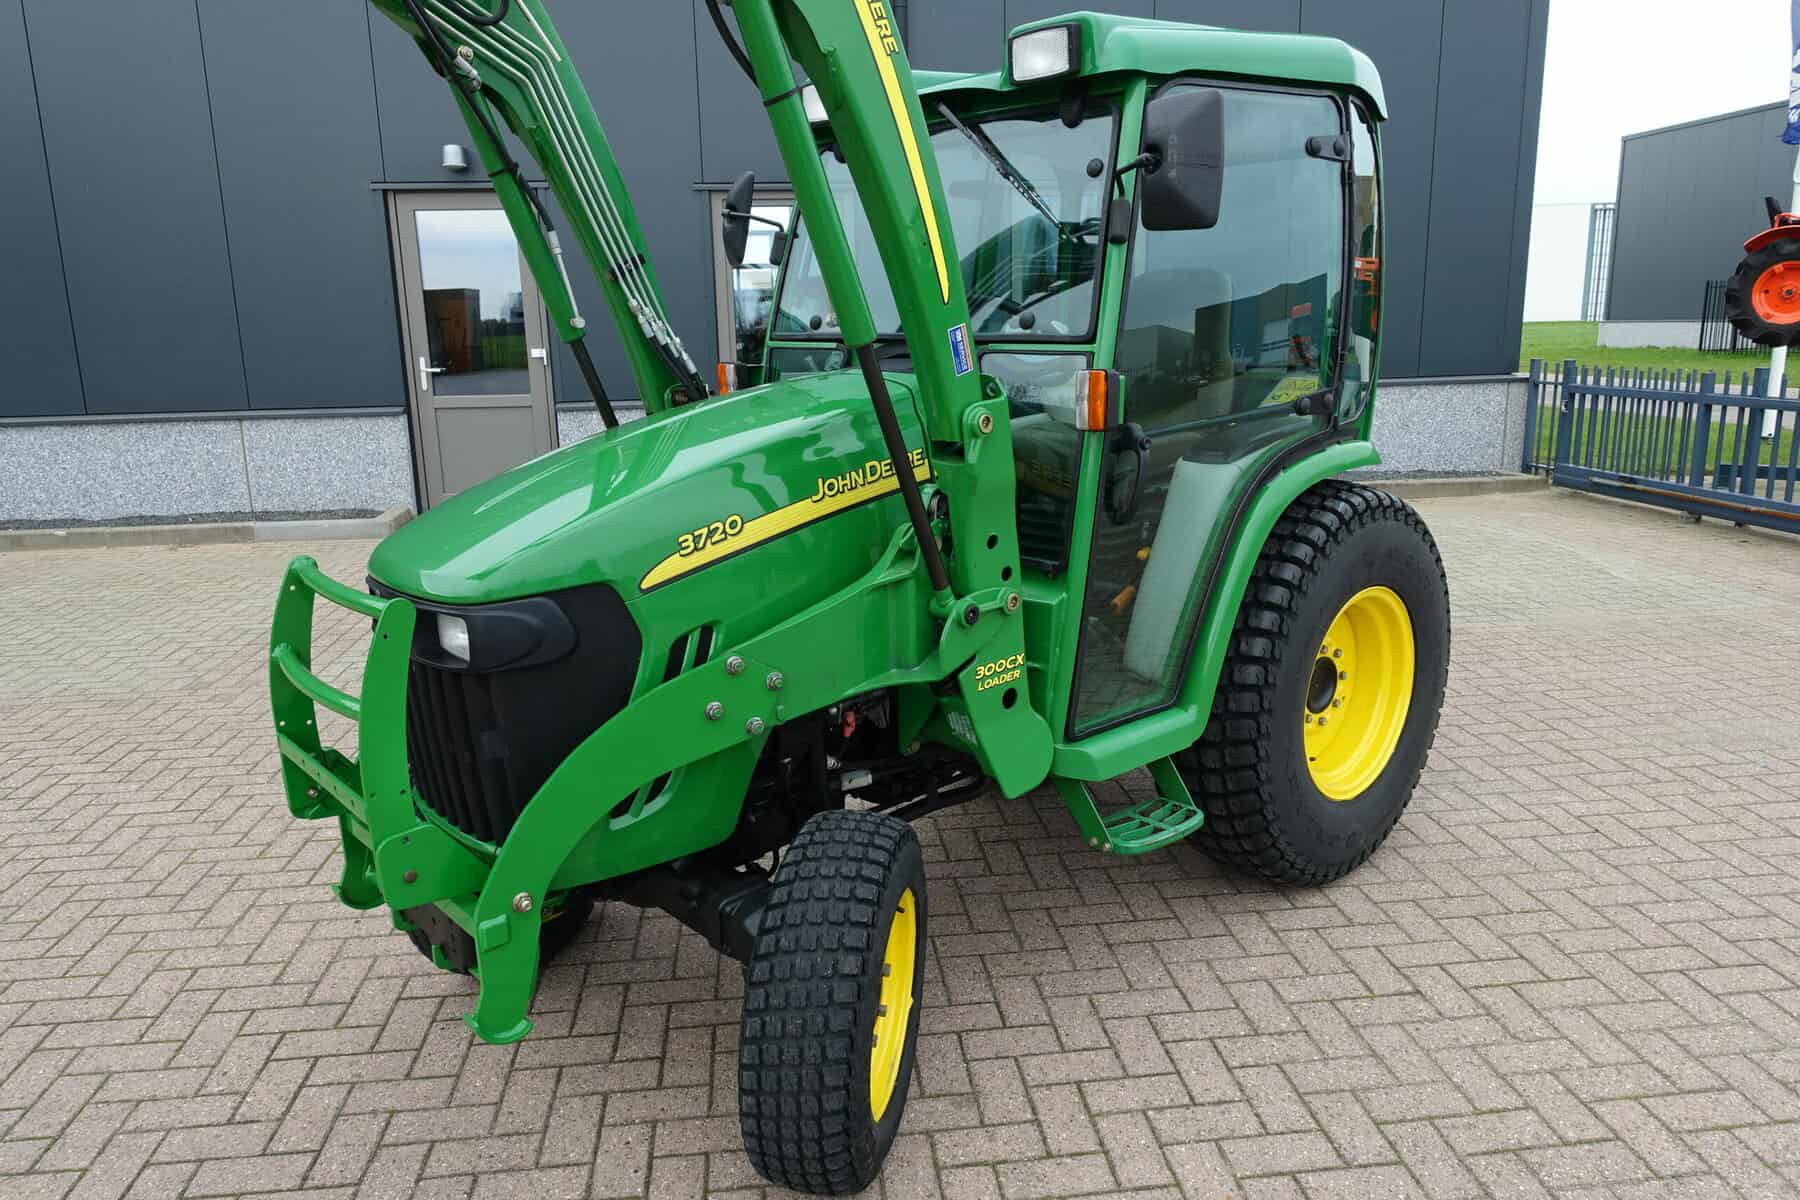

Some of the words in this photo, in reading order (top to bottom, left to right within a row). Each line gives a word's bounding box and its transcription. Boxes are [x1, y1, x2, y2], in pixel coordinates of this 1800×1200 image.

[868, 0, 898, 55] ERE
[811, 468, 865, 502] JOHN
[865, 448, 923, 482] DEE
[677, 515, 743, 556] 3720
[976, 653, 1025, 679] 300CX
[978, 670, 1020, 691] LOADER
